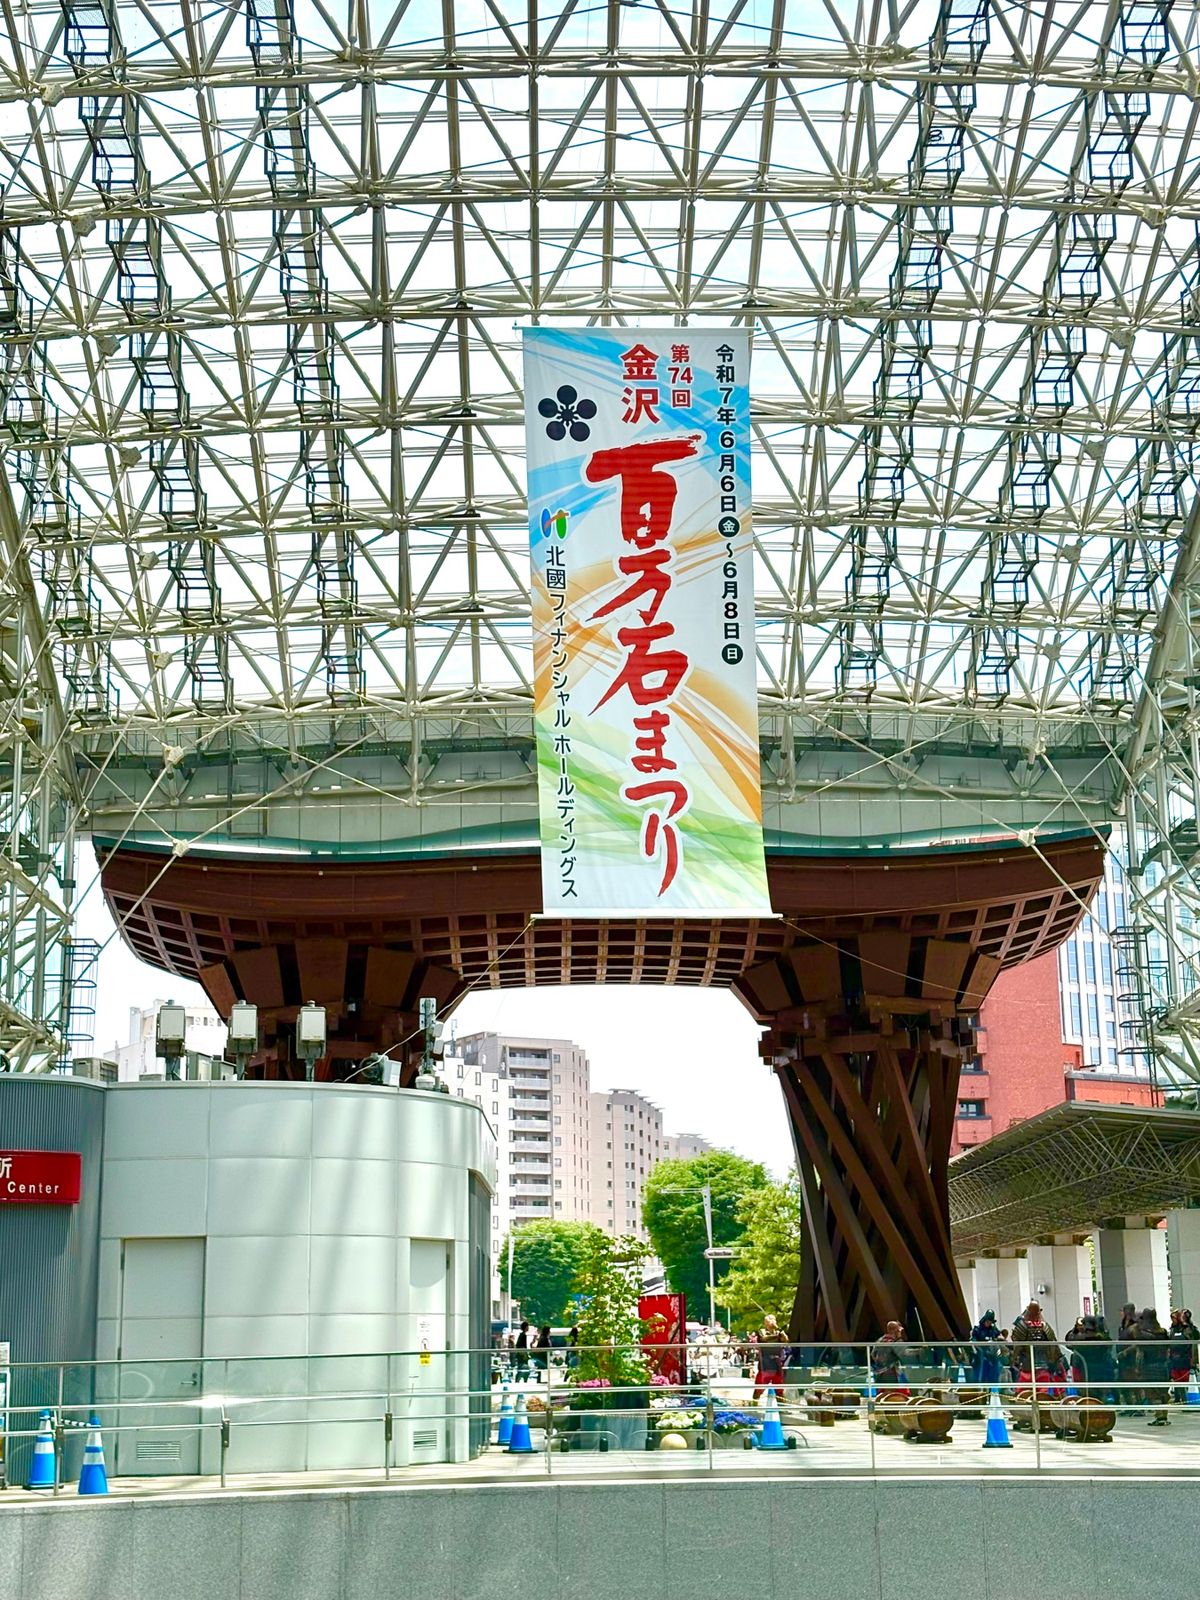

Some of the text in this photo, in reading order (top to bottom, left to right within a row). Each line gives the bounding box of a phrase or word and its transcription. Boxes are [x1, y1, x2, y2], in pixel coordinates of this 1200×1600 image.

[620, 343, 660, 424] 金沢
[667, 343, 694, 408] 第74回
[586, 434, 702, 898] 百万石まつり
[7, 1181, 60, 1194] Center
